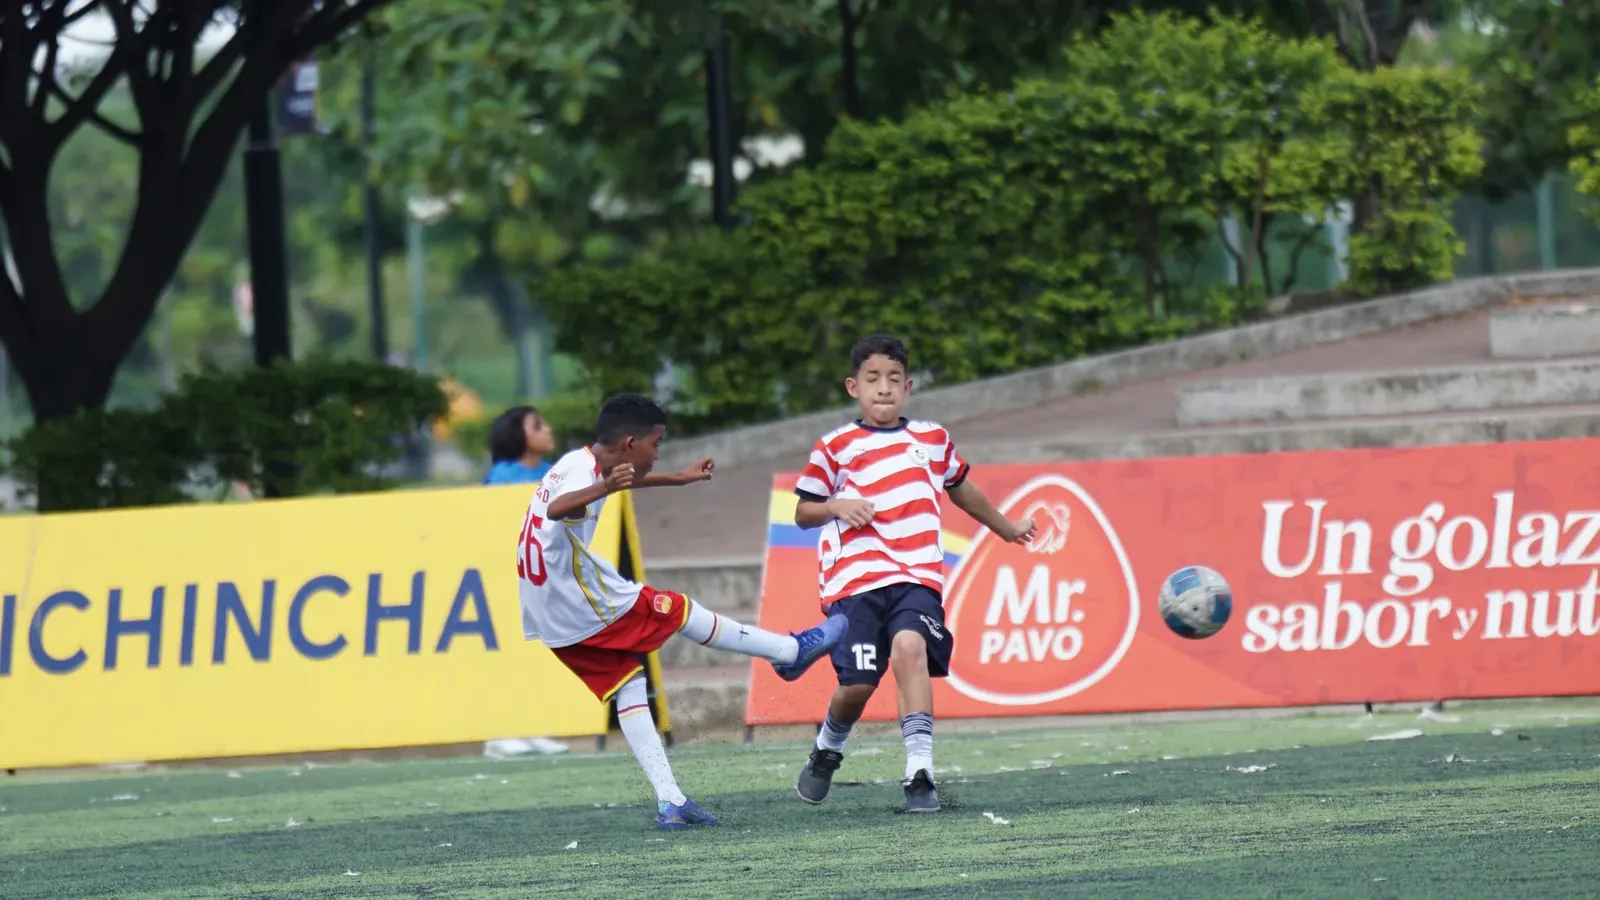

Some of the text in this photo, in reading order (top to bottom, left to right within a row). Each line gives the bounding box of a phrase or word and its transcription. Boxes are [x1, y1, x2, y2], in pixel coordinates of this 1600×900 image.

[1261, 490, 1600, 596] Un golaz
[0, 568, 500, 677] ICHINCHA
[984, 564, 1086, 626] Mr.
[1241, 581, 1452, 652] sabor
[1452, 608, 1479, 640] y
[851, 644, 877, 671] 12
[979, 627, 1083, 665] PAVO
